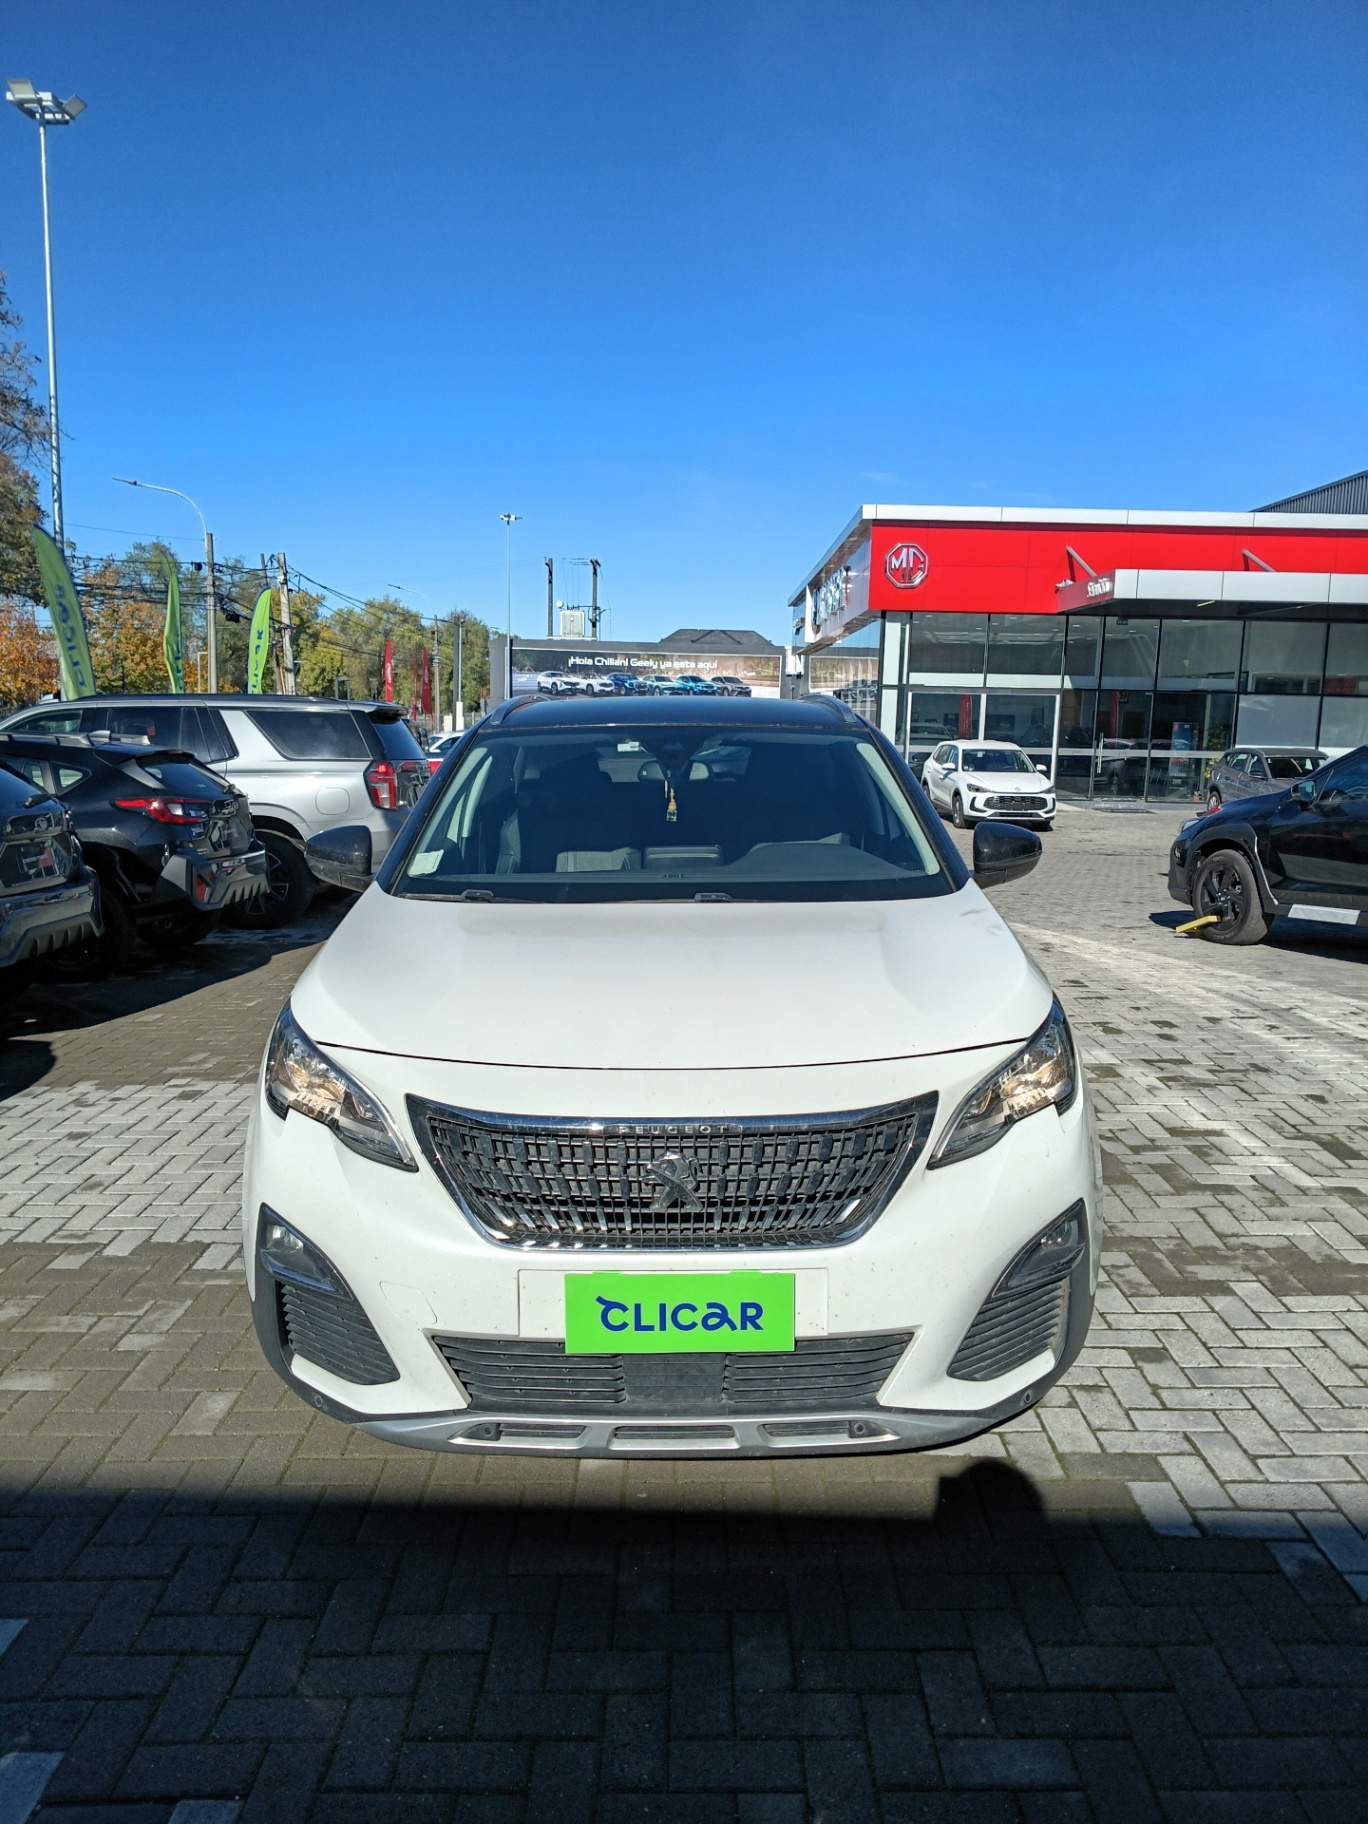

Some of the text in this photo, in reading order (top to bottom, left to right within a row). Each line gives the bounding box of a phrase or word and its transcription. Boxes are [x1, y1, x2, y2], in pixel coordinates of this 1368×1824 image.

[890, 546, 926, 584] MG
[629, 658, 658, 670] Geely
[659, 661, 673, 670] ya
[618, 1124, 729, 1135] PEUGEOT
